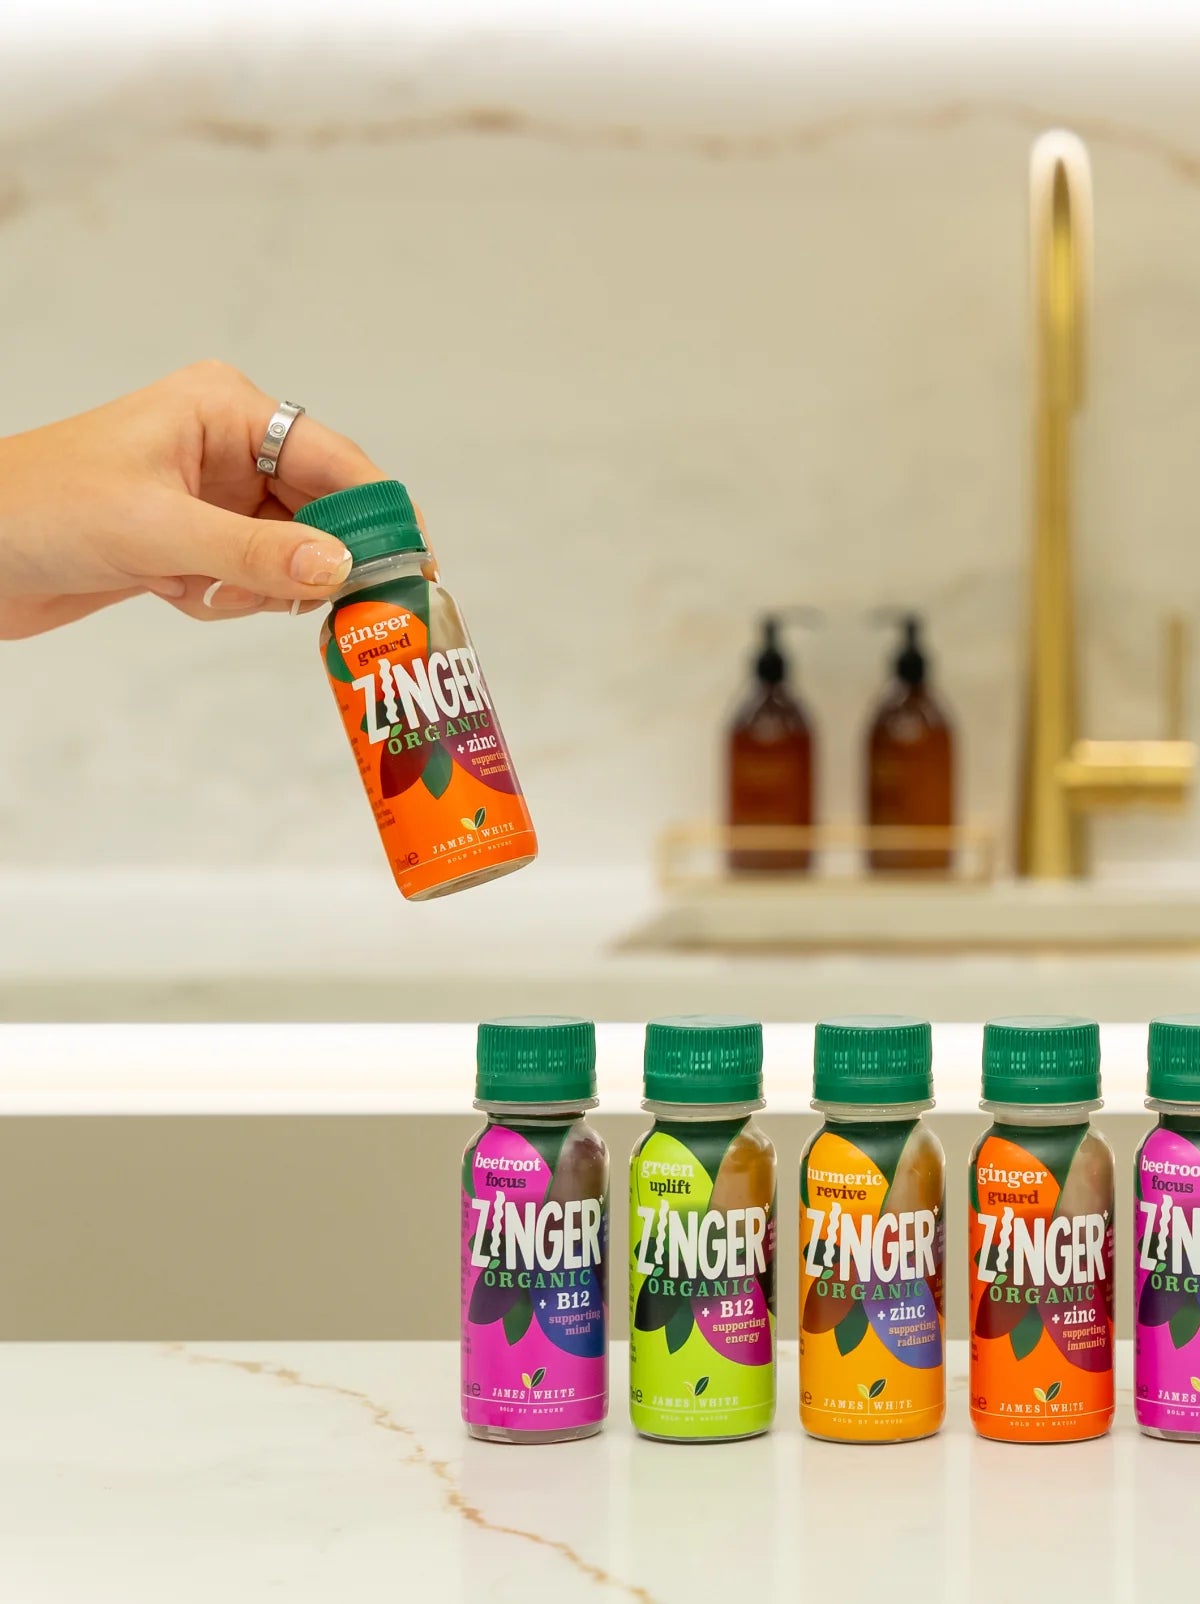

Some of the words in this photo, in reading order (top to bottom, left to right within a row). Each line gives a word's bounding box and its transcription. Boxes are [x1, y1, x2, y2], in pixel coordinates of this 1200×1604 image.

[339, 613, 411, 653] ginger
[357, 633, 411, 666] guard
[351, 647, 491, 744] ZINGER
[388, 713, 489, 755] ORGANIC
[466, 733, 497, 752] zinc
[432, 834, 473, 854] JAMES
[481, 822, 515, 838] WHITE
[475, 1152, 541, 1172] beetroot
[641, 1160, 694, 1178] green
[485, 1172, 526, 1188] focus
[807, 1166, 882, 1186] turmeric
[978, 1163, 1048, 1186] ginger
[649, 1179, 691, 1196] uplift
[816, 1185, 867, 1201] revive
[1151, 1176, 1194, 1193] focus
[987, 1190, 1039, 1205] guard
[471, 1190, 601, 1271] ZINGER
[637, 1199, 767, 1279] ZINGER
[805, 1202, 937, 1283] ZINGER
[977, 1206, 1106, 1286] ZINGER
[484, 1269, 591, 1288] ORGANIC
[649, 1277, 755, 1297] ORGANIC
[816, 1279, 925, 1301] ORGANIC
[990, 1283, 1095, 1303] ORGANIC
[557, 1291, 590, 1310] B12
[720, 1299, 754, 1318] B12
[890, 1303, 926, 1320] zinc
[1064, 1305, 1096, 1324] zinc
[492, 1387, 525, 1398] JAMES
[533, 1388, 575, 1399] WHITE
[1158, 1390, 1196, 1403] JAMES
[824, 1398, 863, 1410] JAMES
[874, 1400, 912, 1410] WHITE
[1000, 1402, 1041, 1413] JAMES
[1051, 1402, 1084, 1412] WHITE
